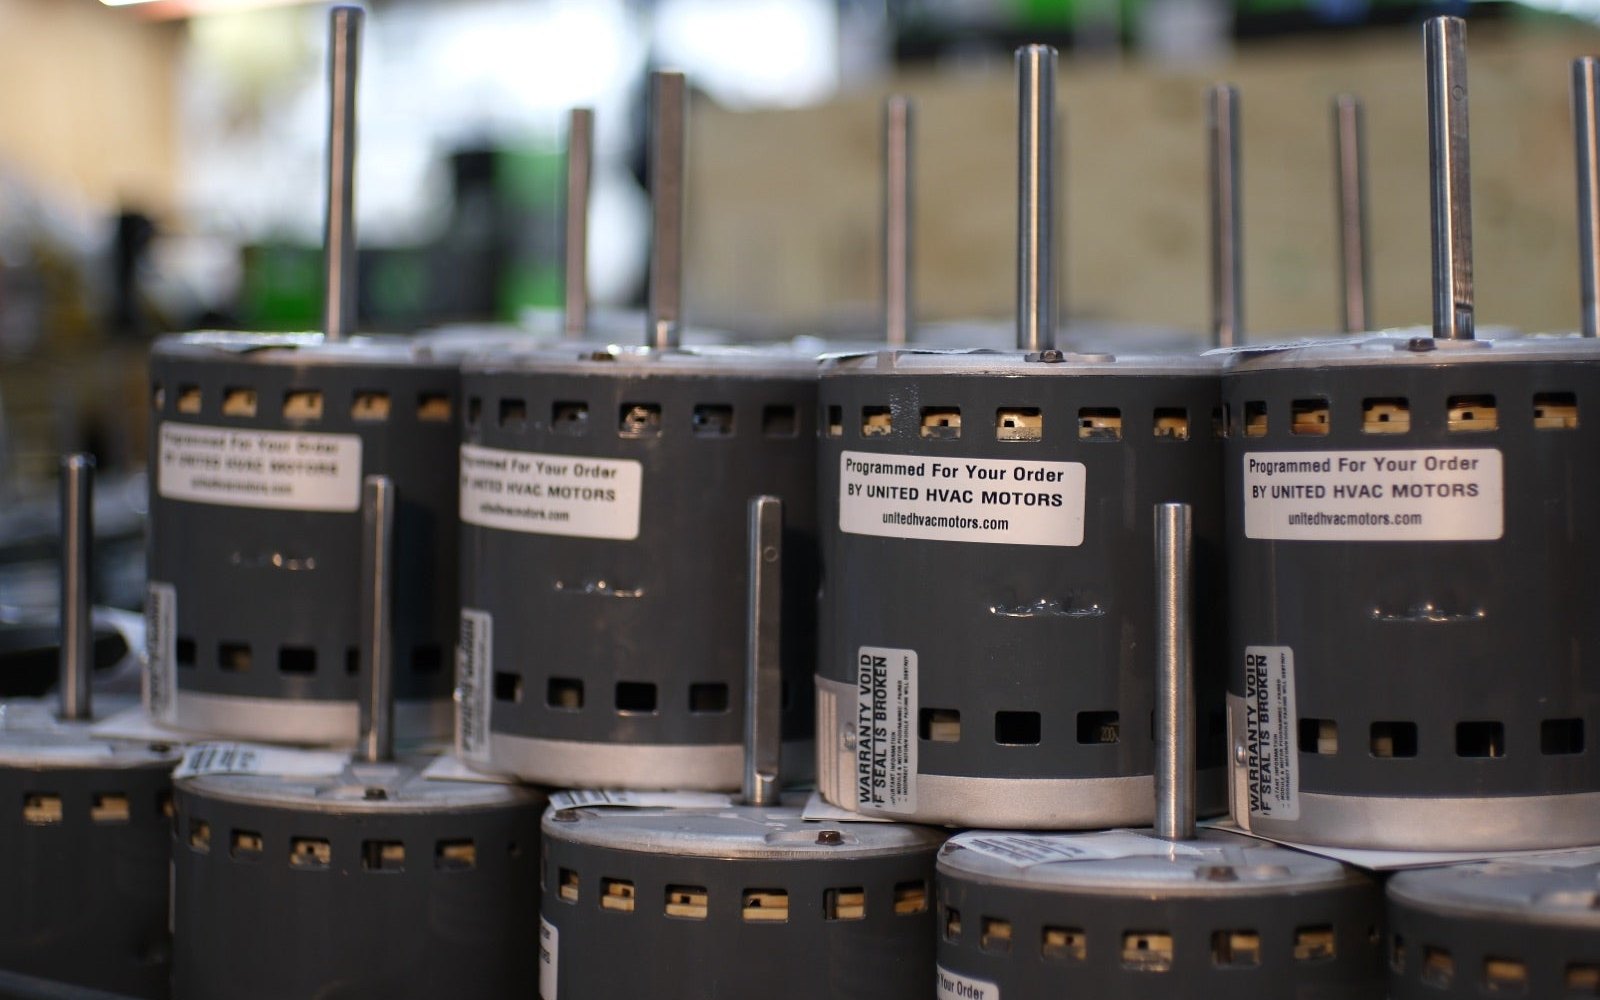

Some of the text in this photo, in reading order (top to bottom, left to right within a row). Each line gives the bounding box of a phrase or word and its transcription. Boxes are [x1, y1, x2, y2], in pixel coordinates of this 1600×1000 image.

[536, 461, 568, 475] Your
[574, 463, 617, 479] Order
[846, 458, 1064, 483] Programmed For Your Order
[1249, 456, 1479, 475] Programmed For Your Order
[507, 483, 542, 497] HVAC
[548, 486, 615, 501] MOTORS
[848, 483, 1063, 507] BY UNITED HVAC MOTORS
[1252, 484, 1479, 498] BY UNITED HVAC MOTORS
[883, 512, 1009, 530] unitedhvacmotors.com
[1288, 512, 1422, 525] unitedhvacmotors.com
[875, 657, 887, 721] BROKEN
[1258, 655, 1269, 723] BROKEN
[859, 654, 871, 803] WARRANTY VOID
[875, 728, 887, 742] IS
[1247, 654, 1260, 812] WARRANTY VOID
[1260, 731, 1270, 746] IS
[875, 750, 887, 788] SEAL
[1262, 753, 1271, 794] SEAL
[940, 973, 954, 993] Your
[957, 981, 984, 1000] Order
